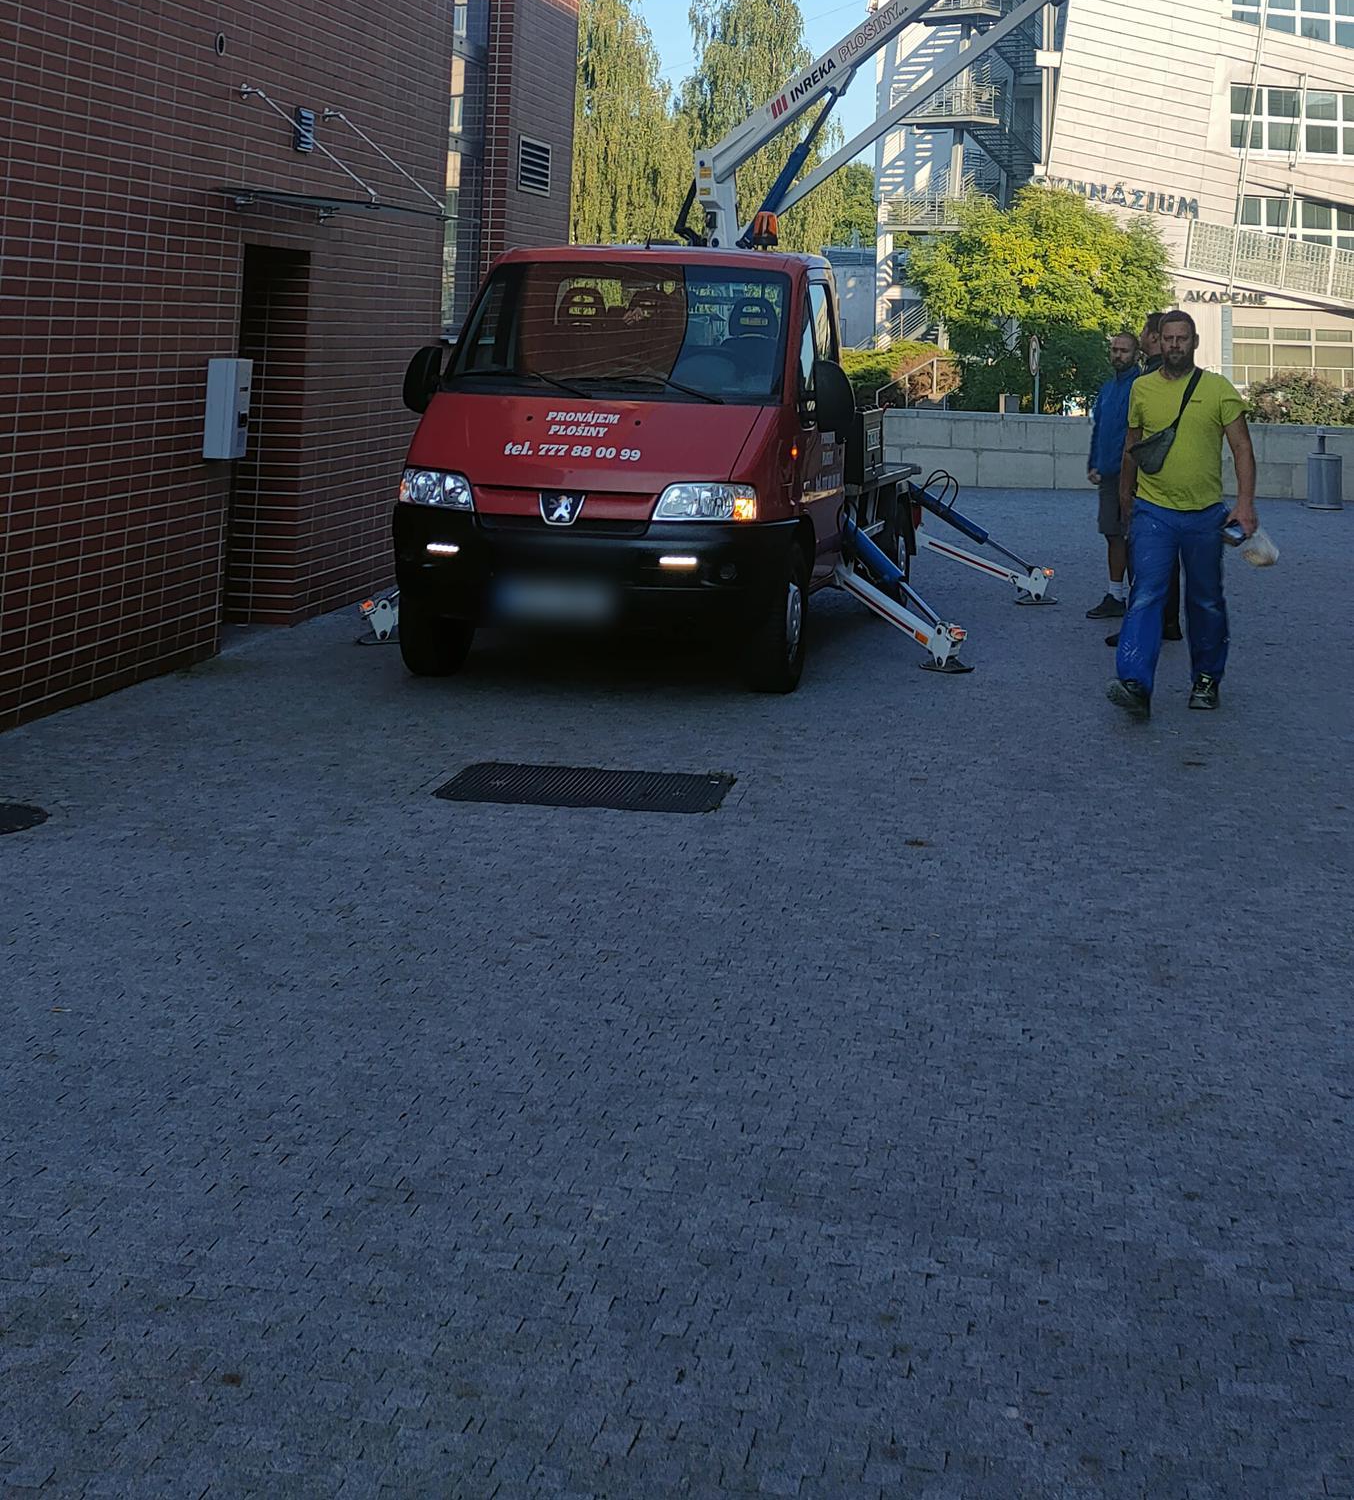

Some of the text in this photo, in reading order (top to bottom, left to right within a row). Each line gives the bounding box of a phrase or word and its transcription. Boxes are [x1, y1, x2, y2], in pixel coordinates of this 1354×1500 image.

[790, 2, 899, 102] INREKA PLOŠINY
[1183, 289, 1267, 305] AKADEMIE
[546, 410, 620, 425] PRONÁJEM
[548, 423, 608, 437] PLOŠINY
[504, 441, 641, 461] tel. 777 88 00 99
